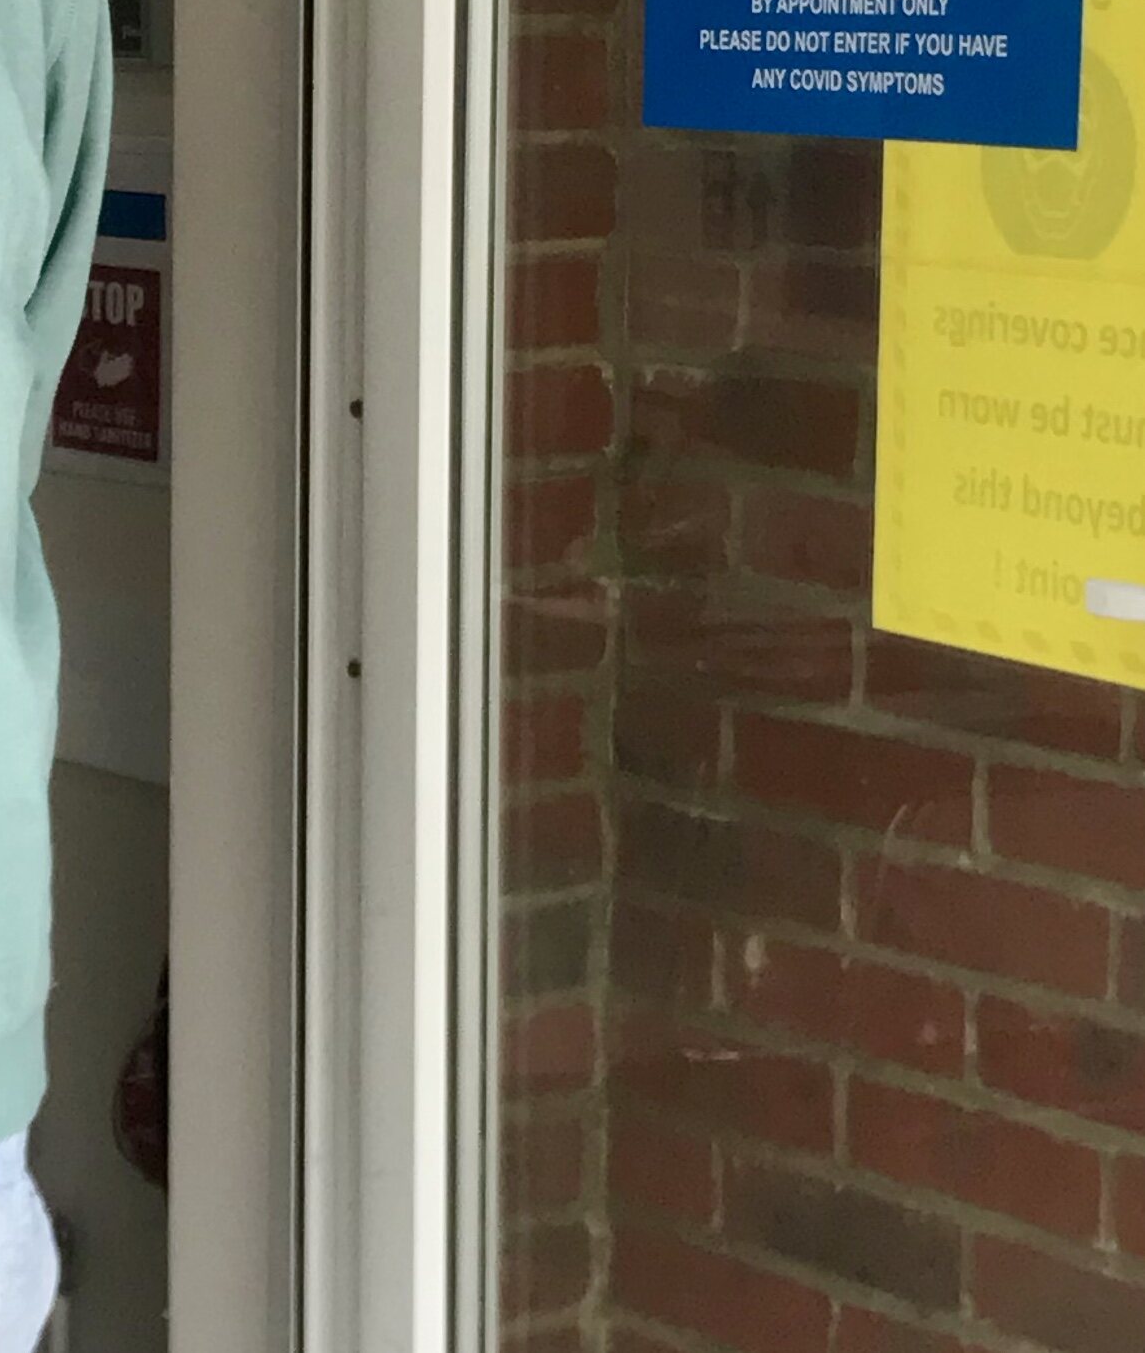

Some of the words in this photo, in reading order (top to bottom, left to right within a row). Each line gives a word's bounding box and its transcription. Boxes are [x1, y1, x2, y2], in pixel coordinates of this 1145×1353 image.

[699, 29, 762, 52] PLEASE
[765, 30, 791, 52] DO
[794, 30, 831, 53] NOT
[833, 31, 891, 55] ENTER
[894, 32, 911, 55] IF
[914, 32, 955, 57] YOU
[958, 34, 1009, 58] HAVE
[751, 67, 787, 90] ANY
[789, 68, 843, 92] COVID
[846, 70, 946, 96] SYMPTOMS
[83, 280, 145, 327] TOP
